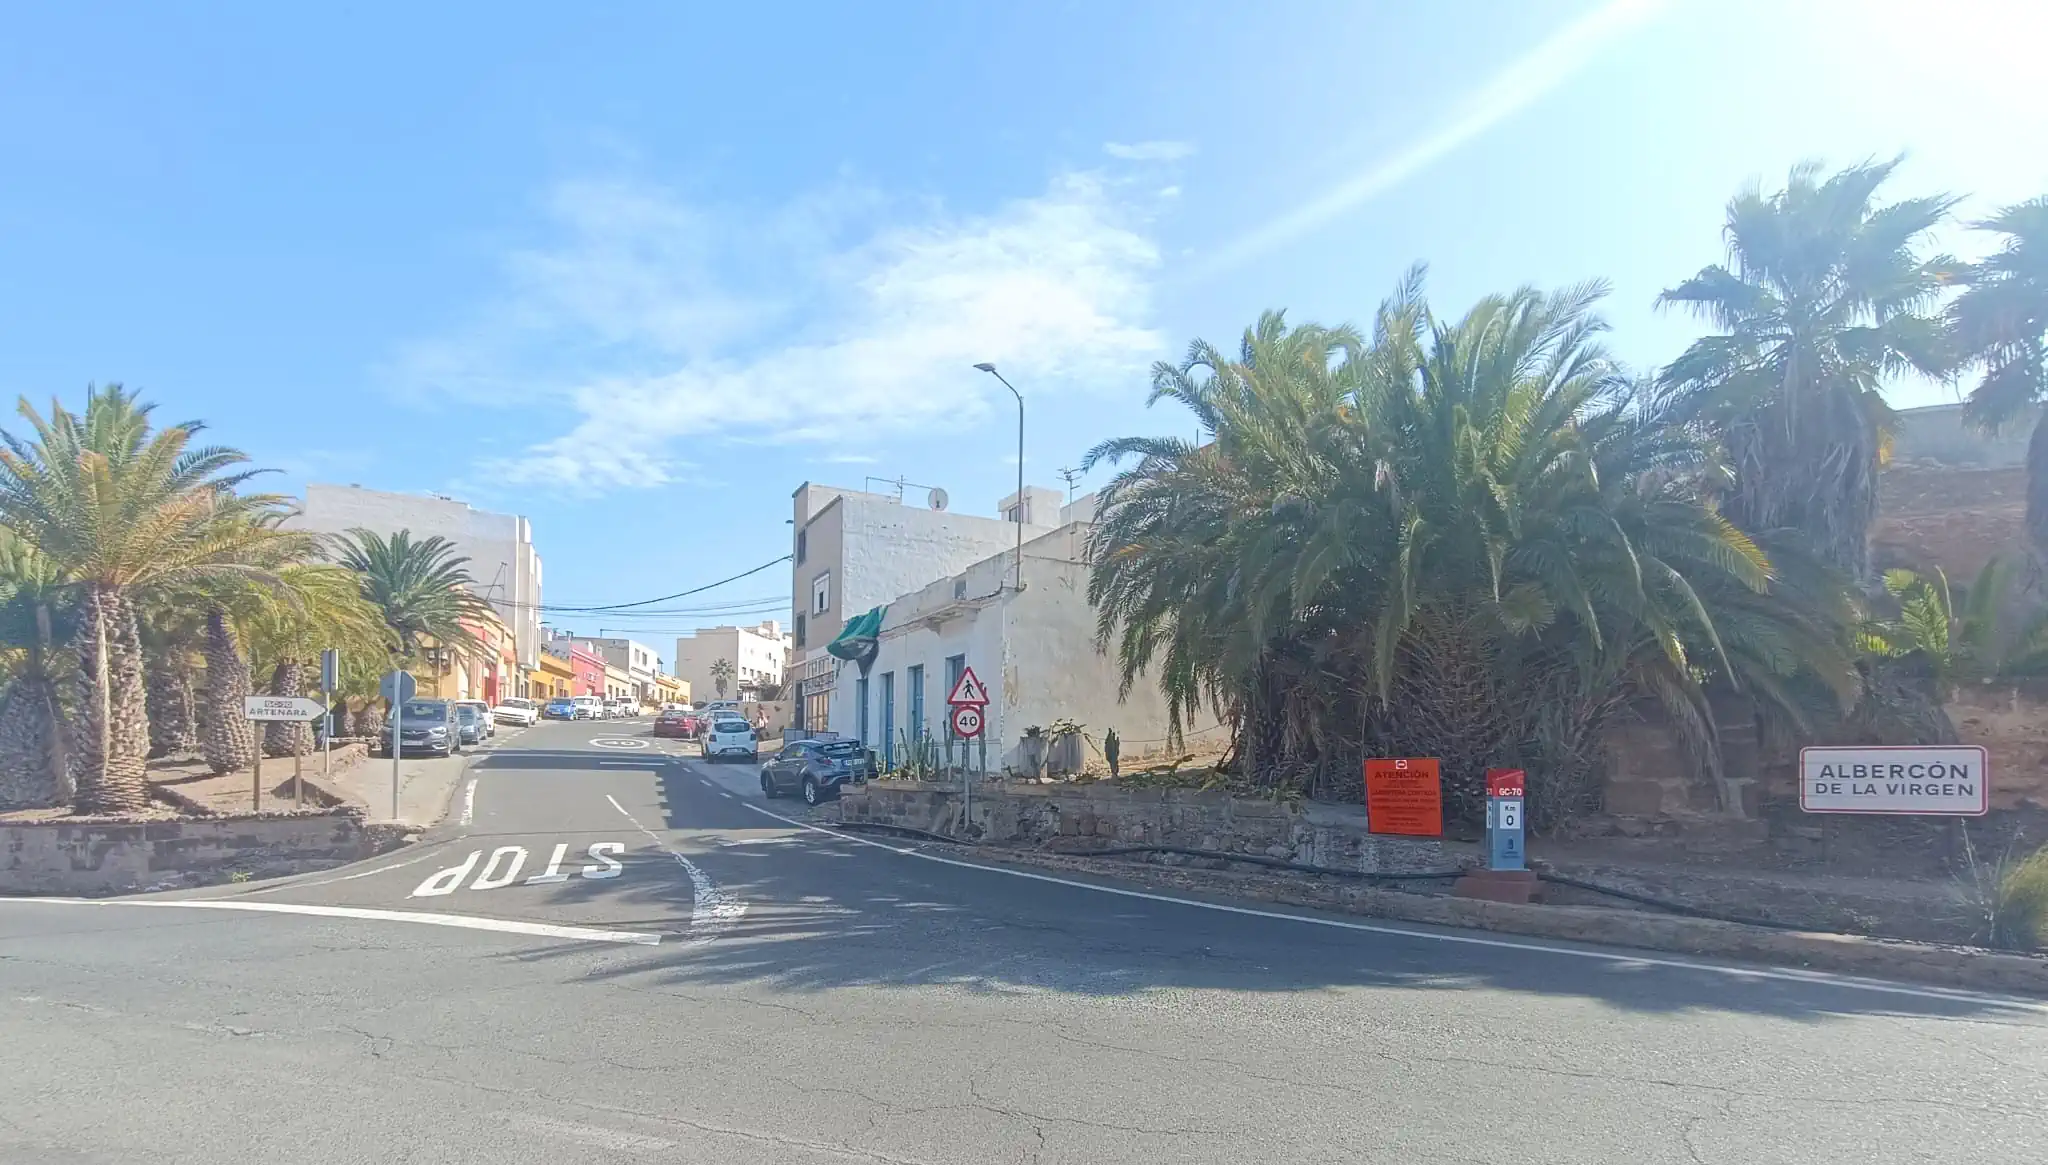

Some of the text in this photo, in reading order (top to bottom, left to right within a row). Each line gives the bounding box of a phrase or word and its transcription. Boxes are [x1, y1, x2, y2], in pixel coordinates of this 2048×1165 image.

[249, 708, 307, 716] ARTENARA
[959, 716, 978, 727] 40
[1374, 770, 1429, 779] ATENCIÓN
[1819, 761, 1969, 779] ALBERCÓN
[1498, 787, 1522, 796] GC-70
[1815, 783, 1974, 796] DE LA VIRGEN
[1504, 804, 1517, 812] Km
[1506, 815, 1514, 826] 0
[406, 842, 625, 899] STOP
